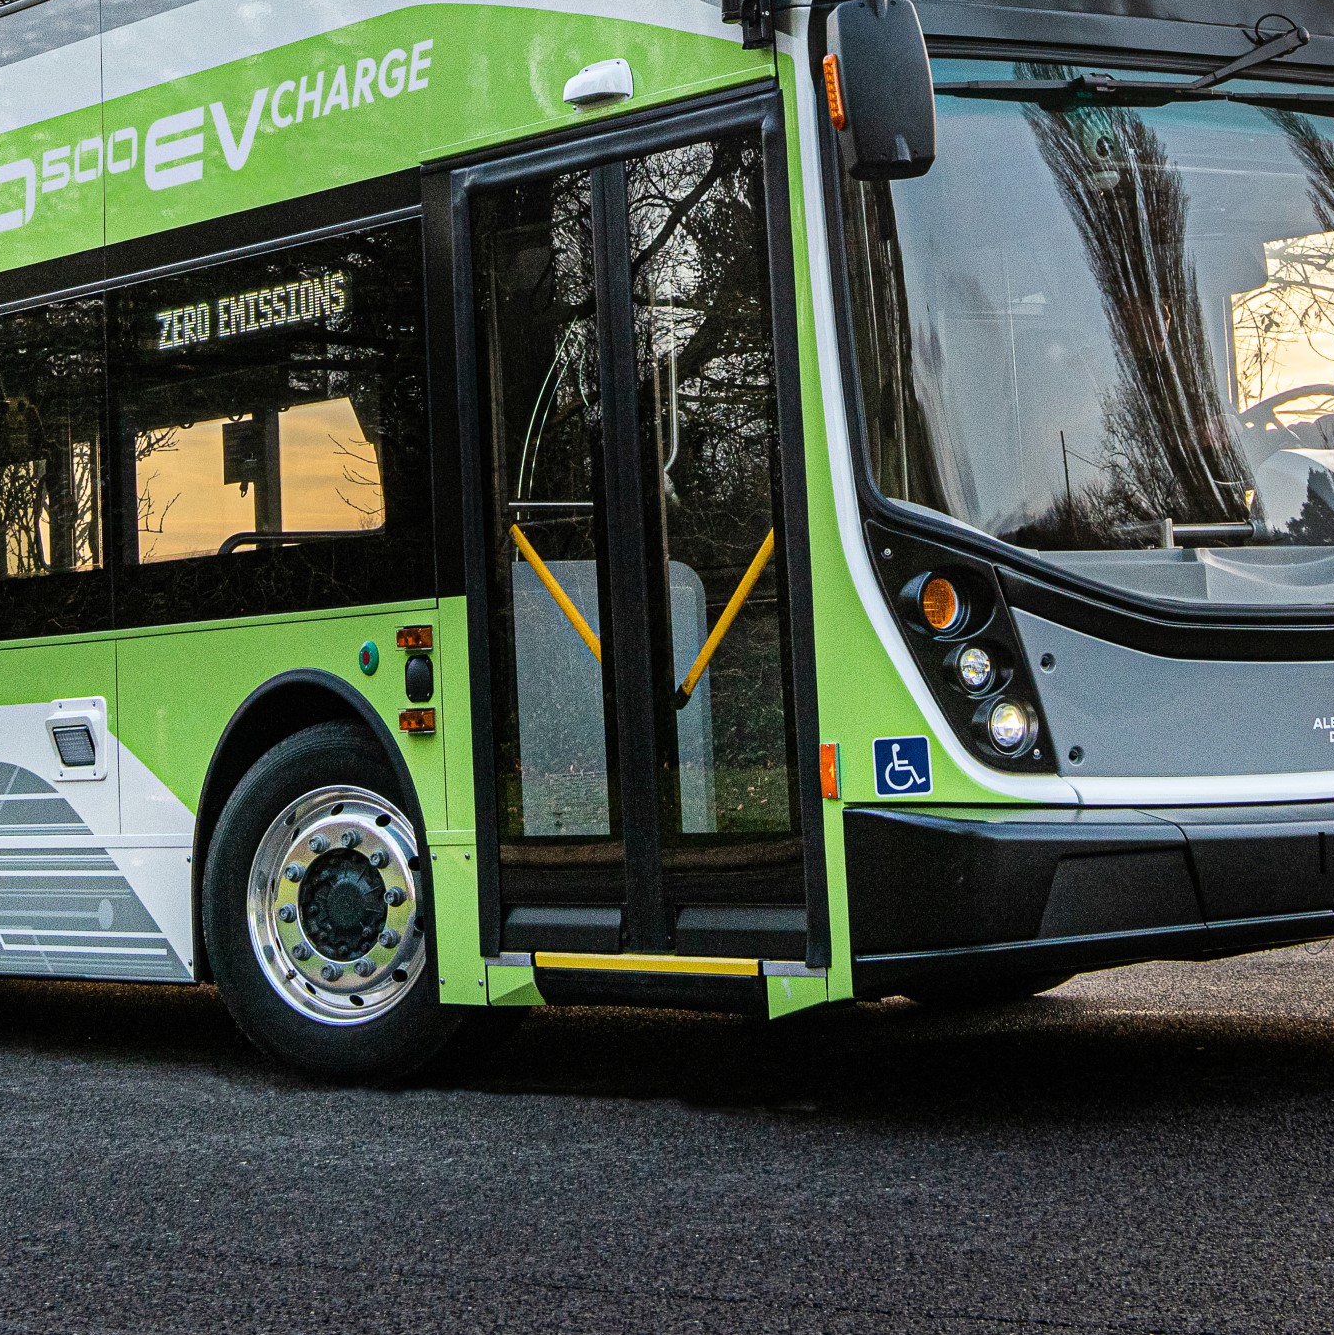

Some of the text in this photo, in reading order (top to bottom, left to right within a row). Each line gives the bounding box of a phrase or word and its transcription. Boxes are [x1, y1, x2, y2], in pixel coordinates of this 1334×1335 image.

[269, 39, 434, 128] CHARGE
[157, 270, 346, 350] ZERO EMISSIONS
